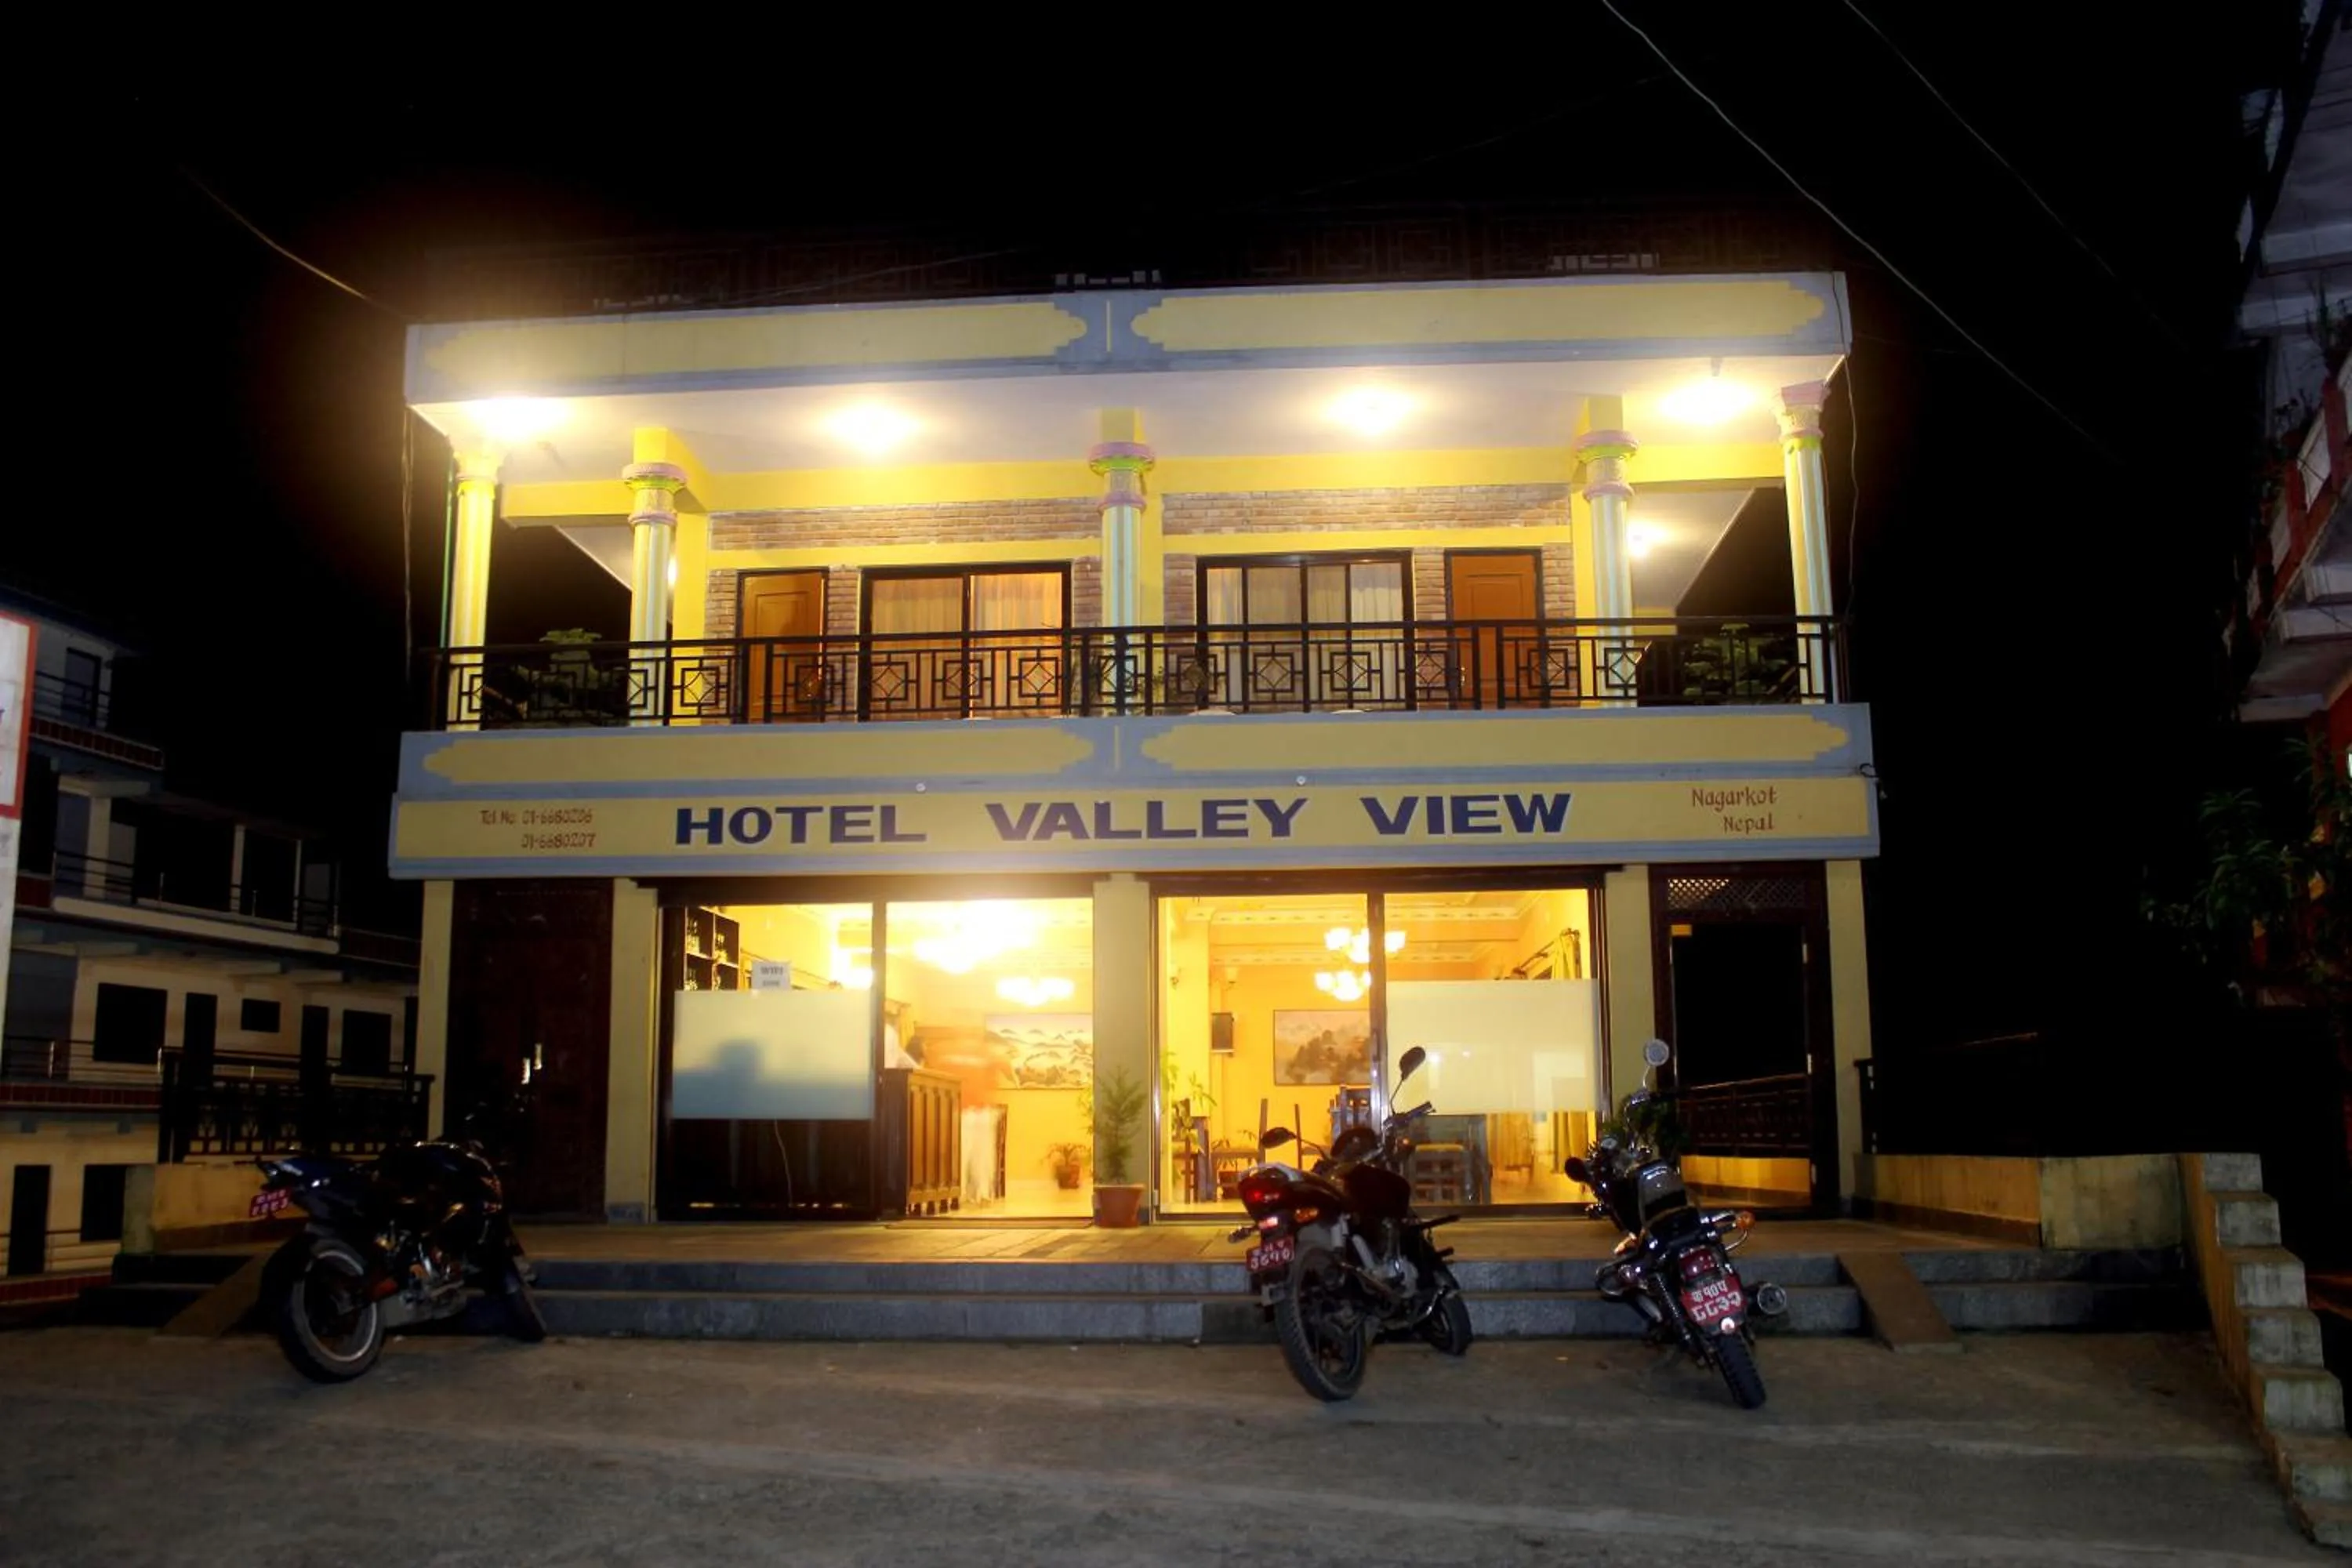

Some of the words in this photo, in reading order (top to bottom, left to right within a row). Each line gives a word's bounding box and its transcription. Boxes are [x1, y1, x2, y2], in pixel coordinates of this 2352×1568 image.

[1691, 786, 1777, 812] Nagarkot
[676, 804, 927, 844] HOTEL
[985, 798, 1308, 841] VALLEY
[1359, 793, 1571, 835] VIEW
[1723, 813, 1775, 834] Nepal
